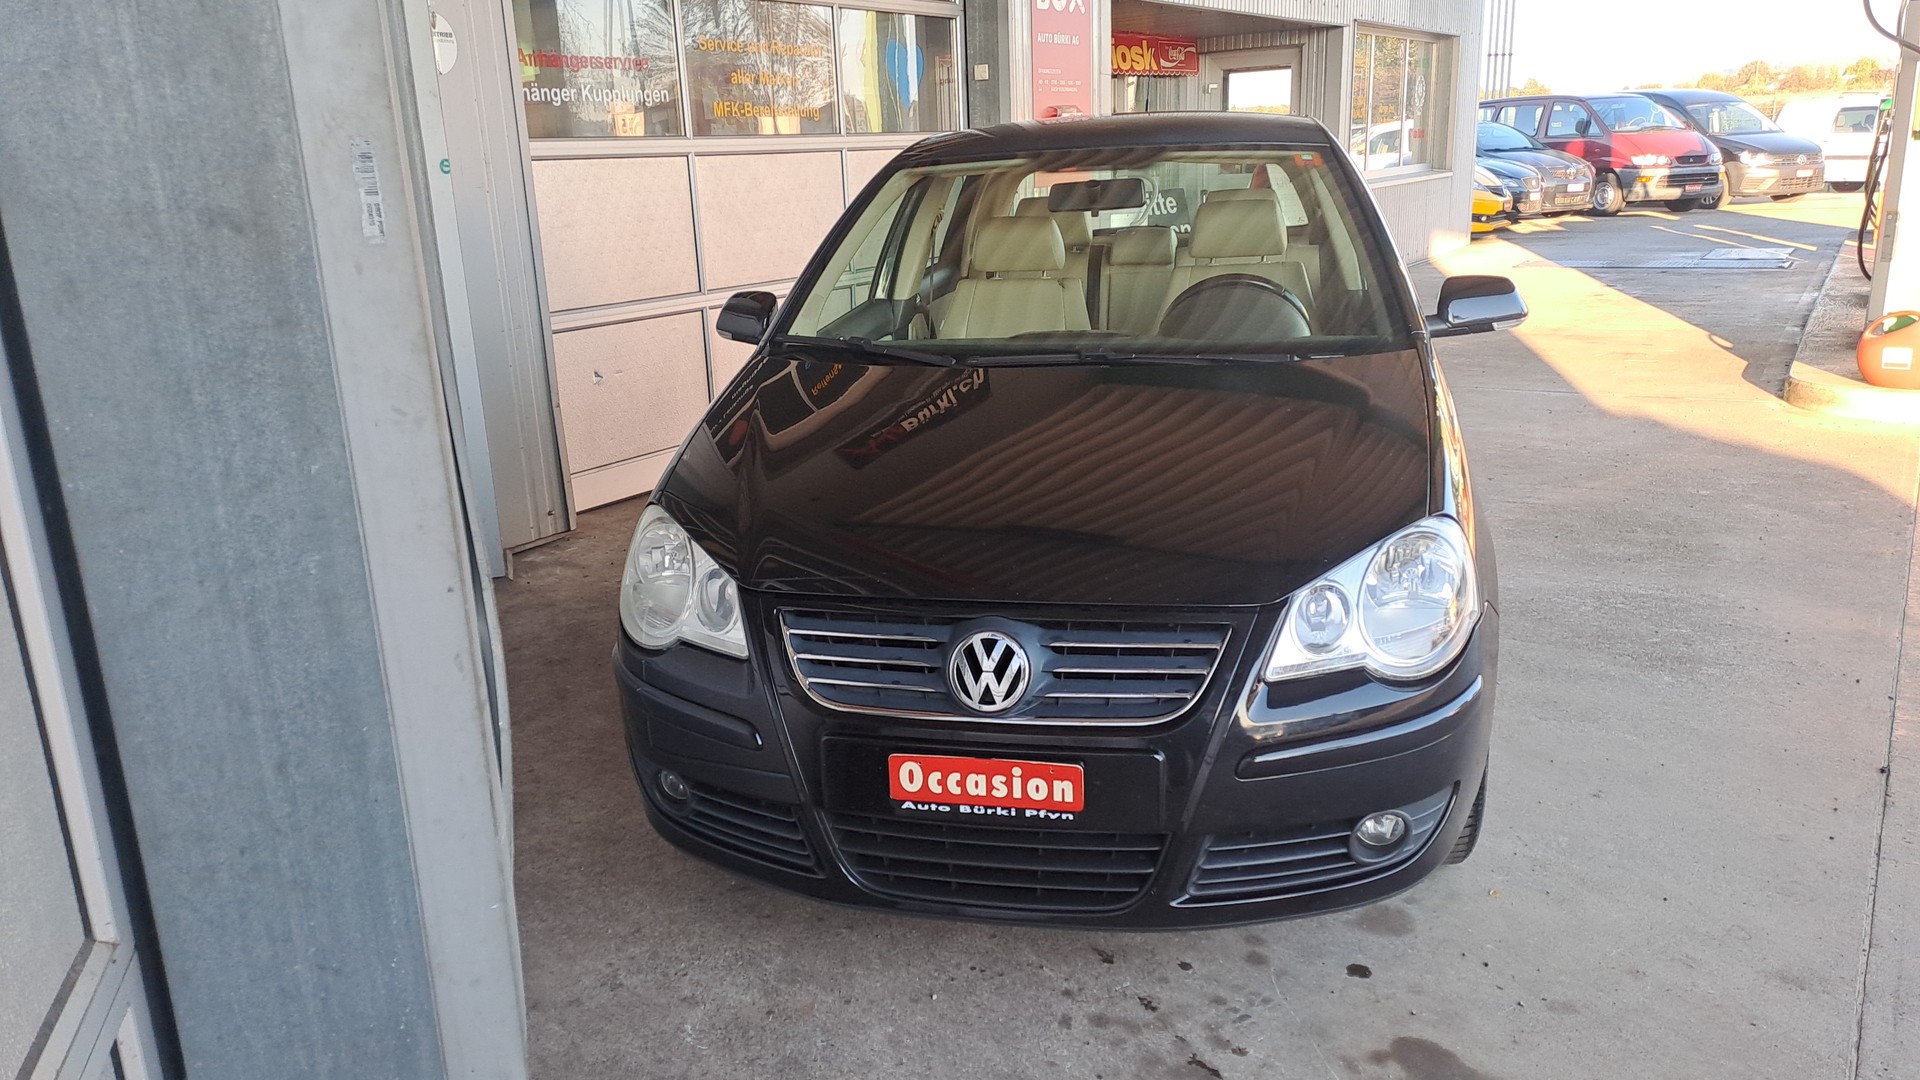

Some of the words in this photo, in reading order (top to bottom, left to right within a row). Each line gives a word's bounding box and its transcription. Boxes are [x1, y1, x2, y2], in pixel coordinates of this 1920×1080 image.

[699, 35, 744, 53] Service
[1037, 32, 1053, 43] AUTO
[1071, 35, 1080, 46] AG
[1112, 37, 1158, 71] iosk
[731, 68, 755, 85] aller
[522, 82, 577, 106] hänger
[581, 84, 670, 107] Kupplungen
[1145, 191, 1178, 215] itte
[898, 760, 1075, 804] Occasion
[901, 801, 951, 813] Auto
[959, 804, 1017, 817] Bürki
[1024, 808, 1075, 821] Pfyn
